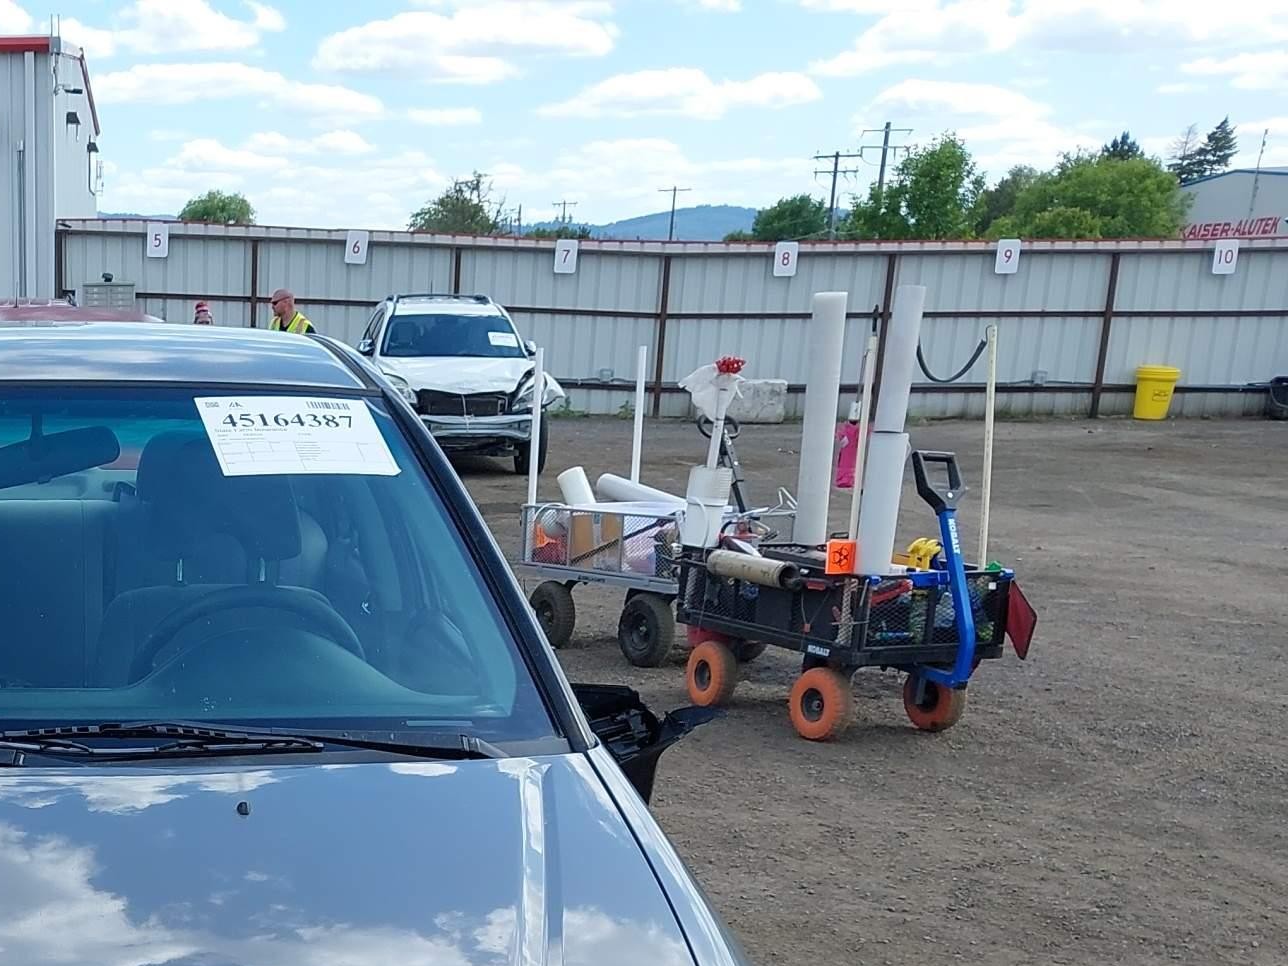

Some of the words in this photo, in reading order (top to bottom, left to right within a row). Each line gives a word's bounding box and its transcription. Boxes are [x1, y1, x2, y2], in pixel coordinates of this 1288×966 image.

[1178, 217, 1281, 239] KAISER-ALUTEK
[154, 233, 162, 248] 5
[352, 240, 360, 254] 6
[562, 249, 570, 264] 7
[781, 251, 790, 266] 8
[1004, 249, 1013, 263] 9
[1218, 249, 1234, 265] 10
[222, 413, 353, 429] 45164387
[948, 518, 961, 555] KOBALT
